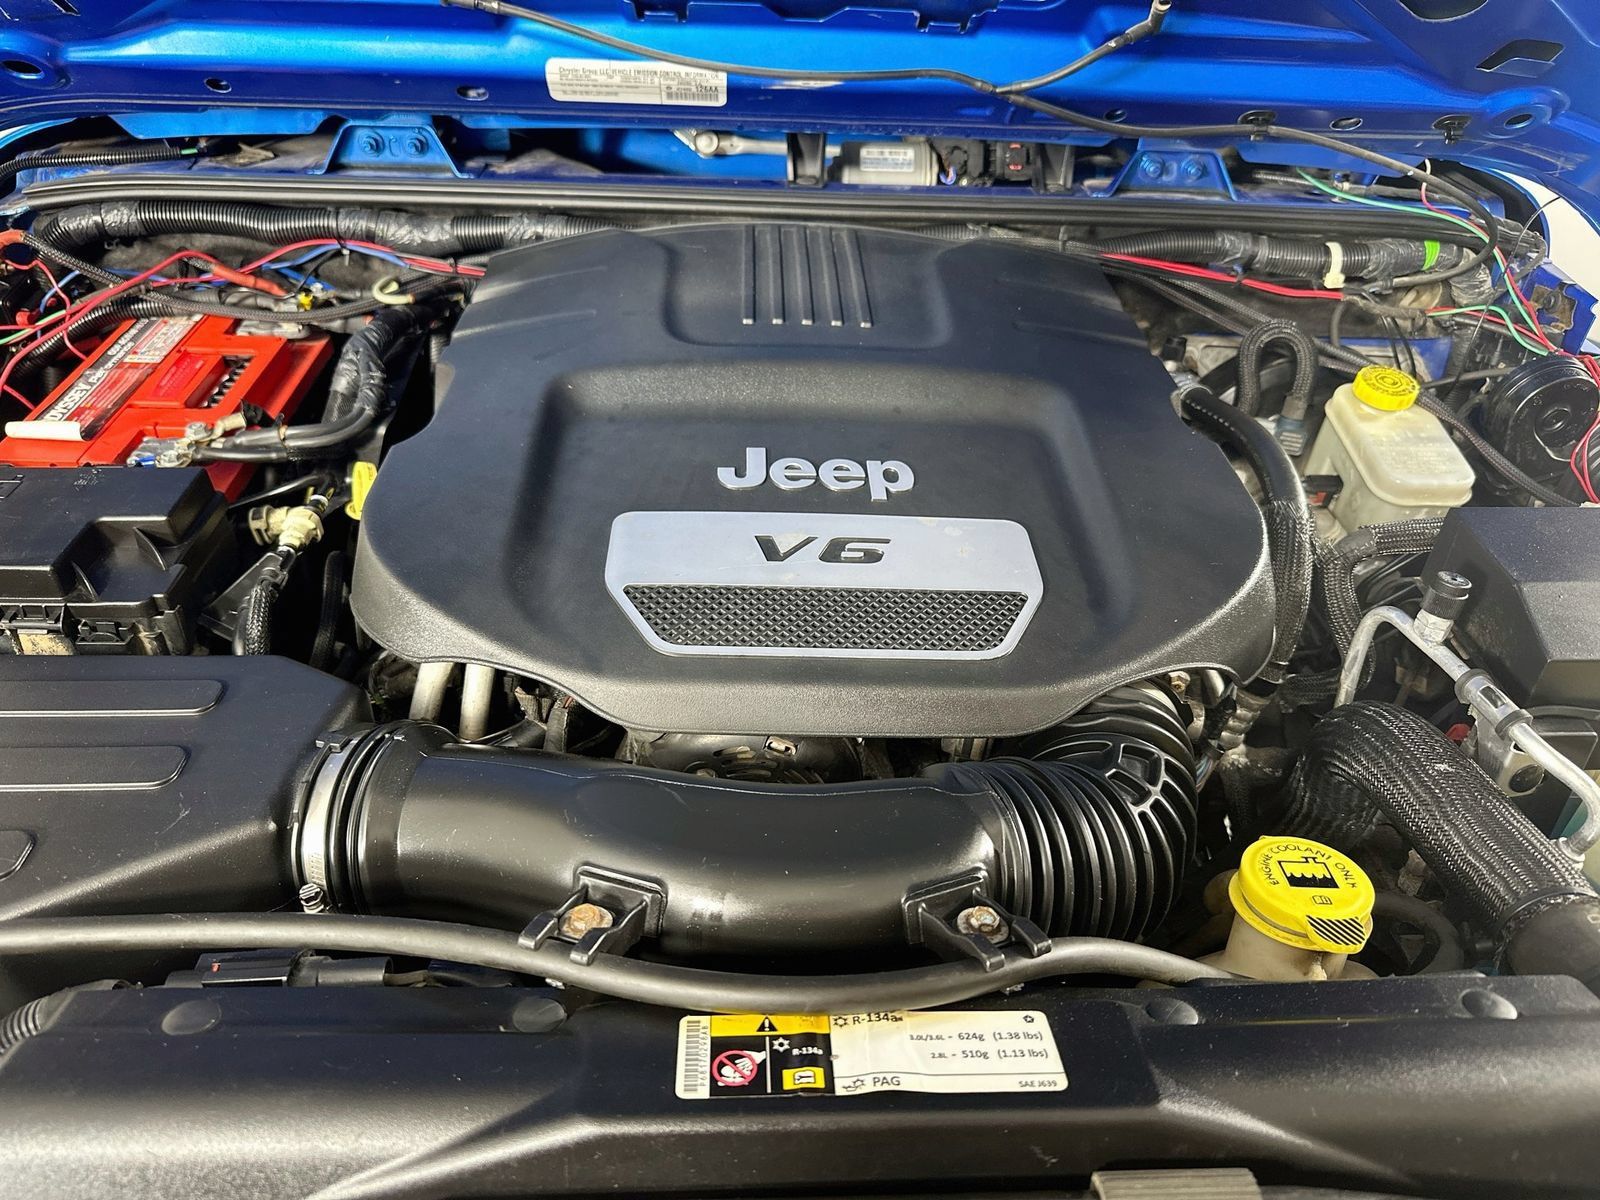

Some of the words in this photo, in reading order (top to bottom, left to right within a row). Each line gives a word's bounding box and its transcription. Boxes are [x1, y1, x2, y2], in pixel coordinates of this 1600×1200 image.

[717, 447, 915, 501] Jeep
[754, 535, 891, 564] V6
[1260, 853, 1280, 886] ENGINE
[1270, 843, 1332, 860] COOLANT
[1335, 862, 1358, 889] ONLY
[958, 1031, 986, 1042] 624g
[993, 1031, 1021, 1042] (1.38
[1022, 1031, 1043, 1041] lbs)
[791, 1046, 824, 1057] R-134a
[961, 1049, 990, 1060] 510g
[997, 1048, 1026, 1060] (1.13
[1027, 1048, 1049, 1060] lbs)
[872, 1076, 901, 1087] PAG
[1018, 1080, 1036, 1088] SAE
